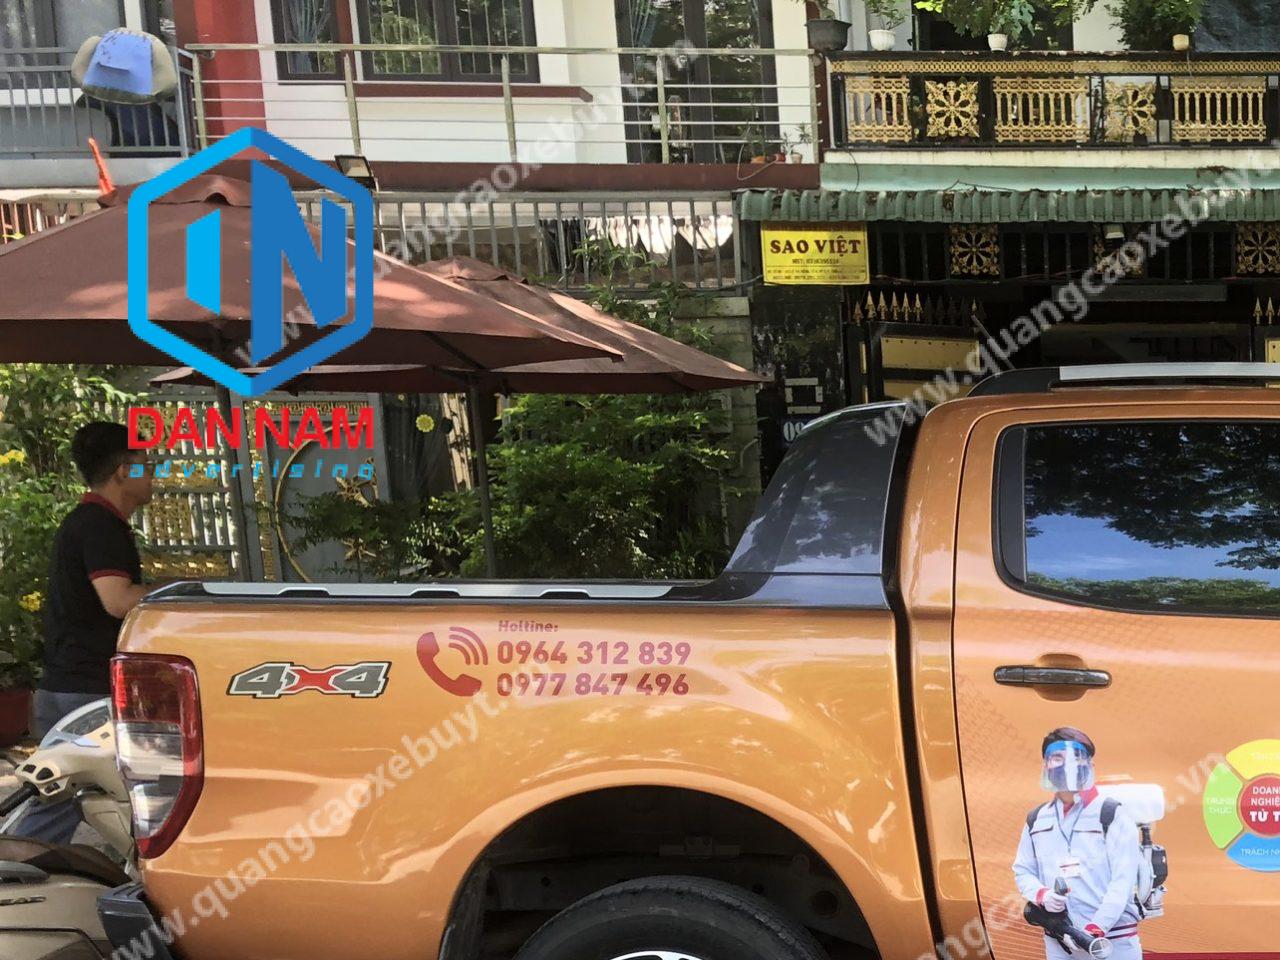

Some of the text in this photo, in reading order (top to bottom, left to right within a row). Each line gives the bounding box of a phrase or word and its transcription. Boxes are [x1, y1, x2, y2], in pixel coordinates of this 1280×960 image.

[770, 235, 861, 257] SAO VIỆT
[497, 641, 691, 664] 0964 312 839
[497, 672, 690, 696] 0977 847 496
